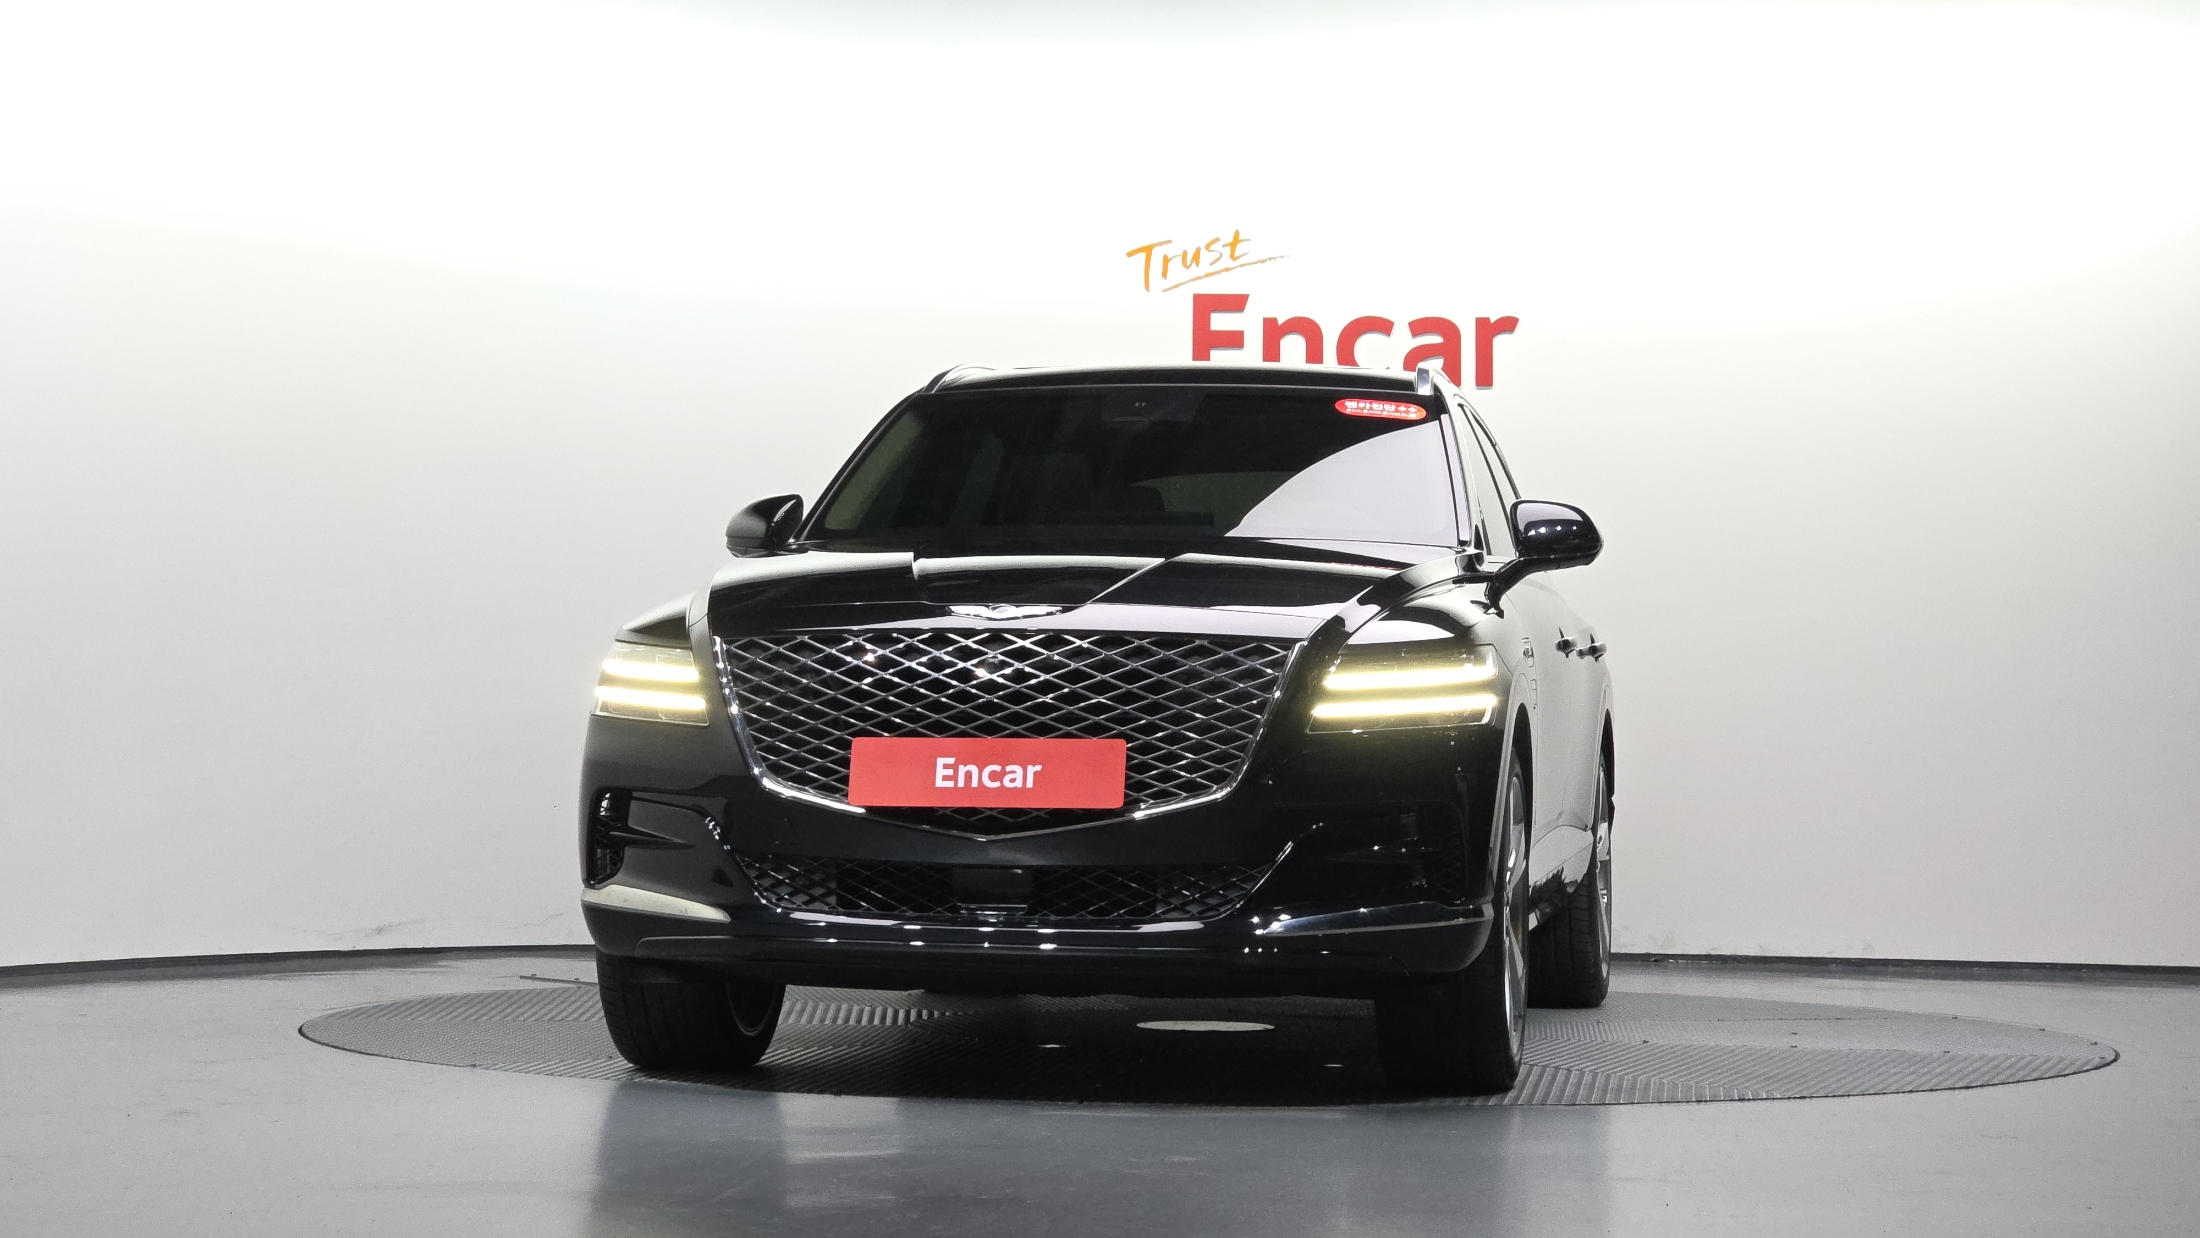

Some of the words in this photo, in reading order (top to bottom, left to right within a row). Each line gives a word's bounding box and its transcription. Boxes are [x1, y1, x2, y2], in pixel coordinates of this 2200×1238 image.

[1126, 229, 1252, 292] Trust
[1192, 293, 1520, 388] Encar
[934, 757, 1043, 789] Encar
